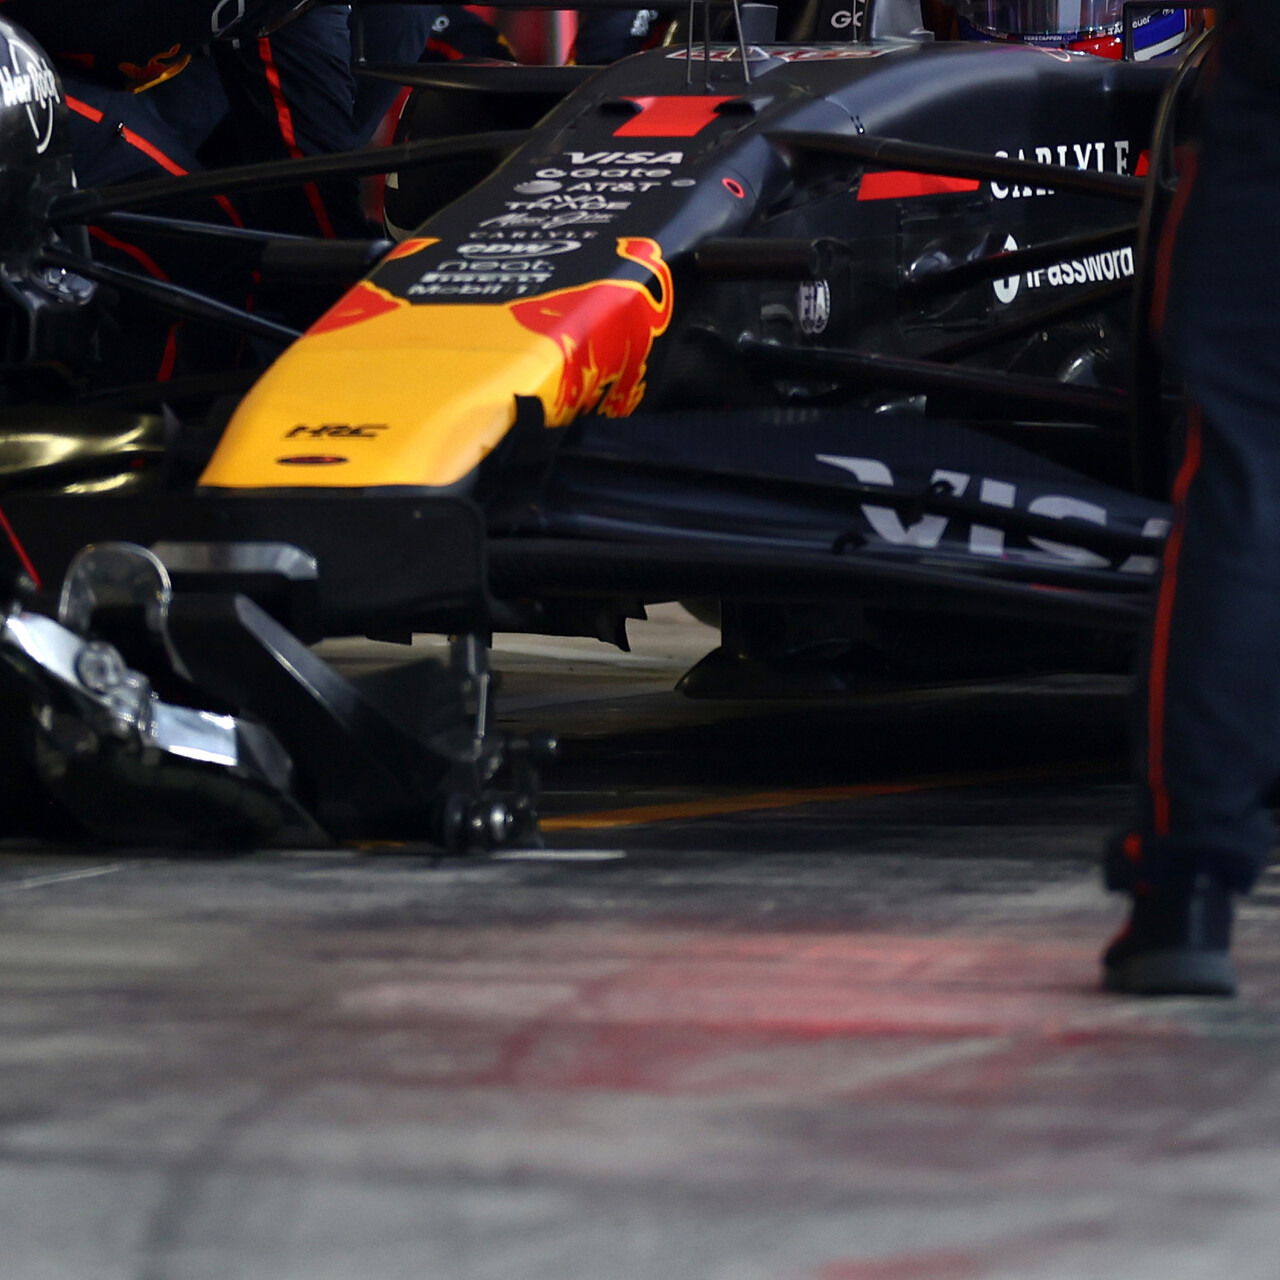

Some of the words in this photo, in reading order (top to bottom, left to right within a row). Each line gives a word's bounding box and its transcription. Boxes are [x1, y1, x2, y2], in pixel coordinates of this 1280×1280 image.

[1131, 16, 1151, 29] euer
[564, 151, 684, 165] VISA
[566, 182, 662, 192] AT&T
